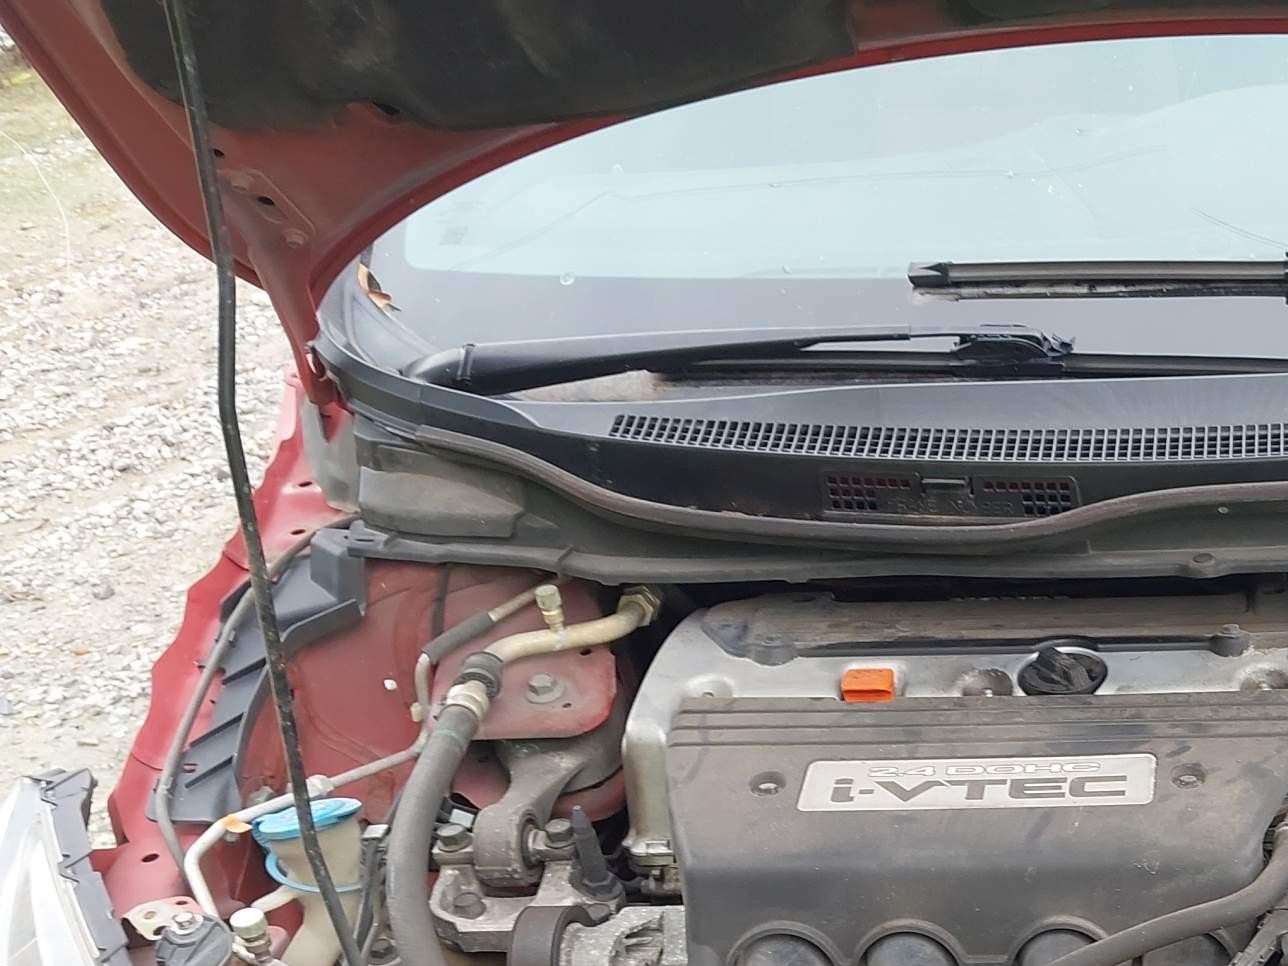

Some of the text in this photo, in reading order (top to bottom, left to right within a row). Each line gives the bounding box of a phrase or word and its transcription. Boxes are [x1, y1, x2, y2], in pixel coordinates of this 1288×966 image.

[867, 761, 1102, 778] 2.4 DOHC
[830, 774, 1128, 803] i-VTEC
